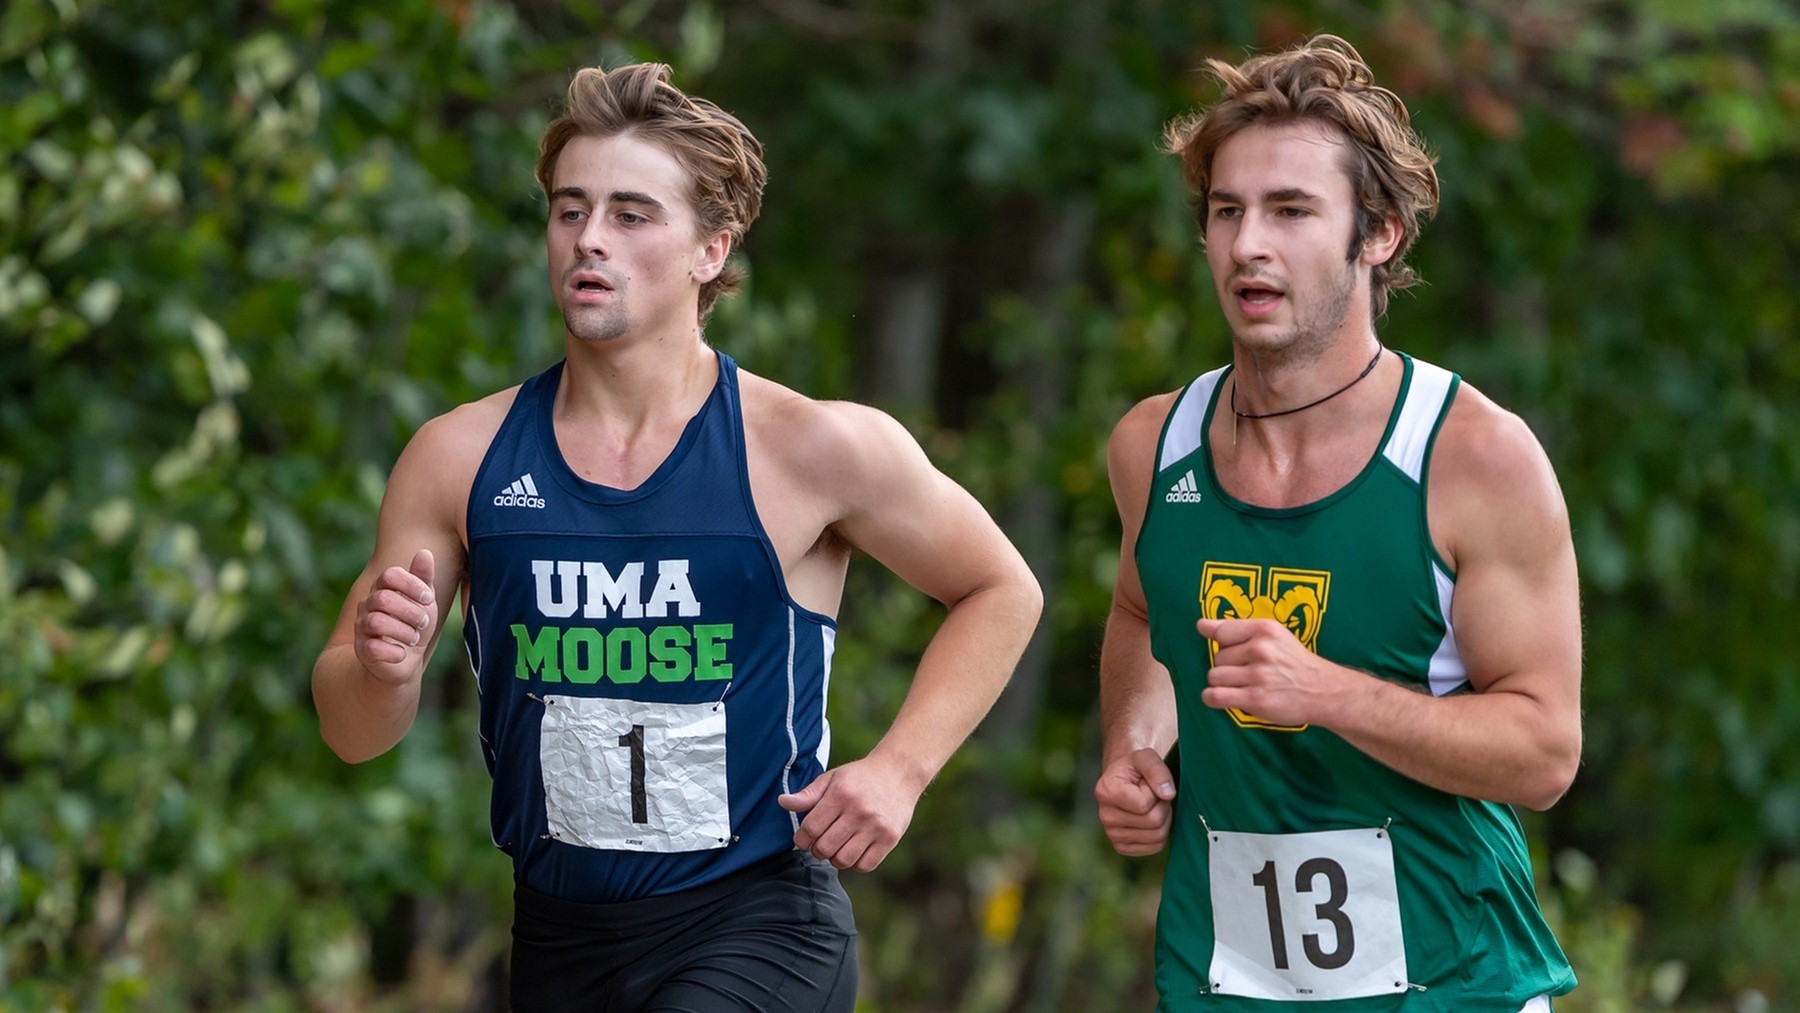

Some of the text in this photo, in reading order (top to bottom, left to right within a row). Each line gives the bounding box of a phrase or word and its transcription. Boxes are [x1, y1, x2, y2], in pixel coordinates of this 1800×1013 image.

[493, 493, 546, 509] adidas
[1166, 490, 1202, 503] adidas
[531, 559, 701, 619] UMA
[511, 623, 734, 685] MOOSE
[618, 725, 648, 825] 1
[1252, 857, 1355, 970] 13
